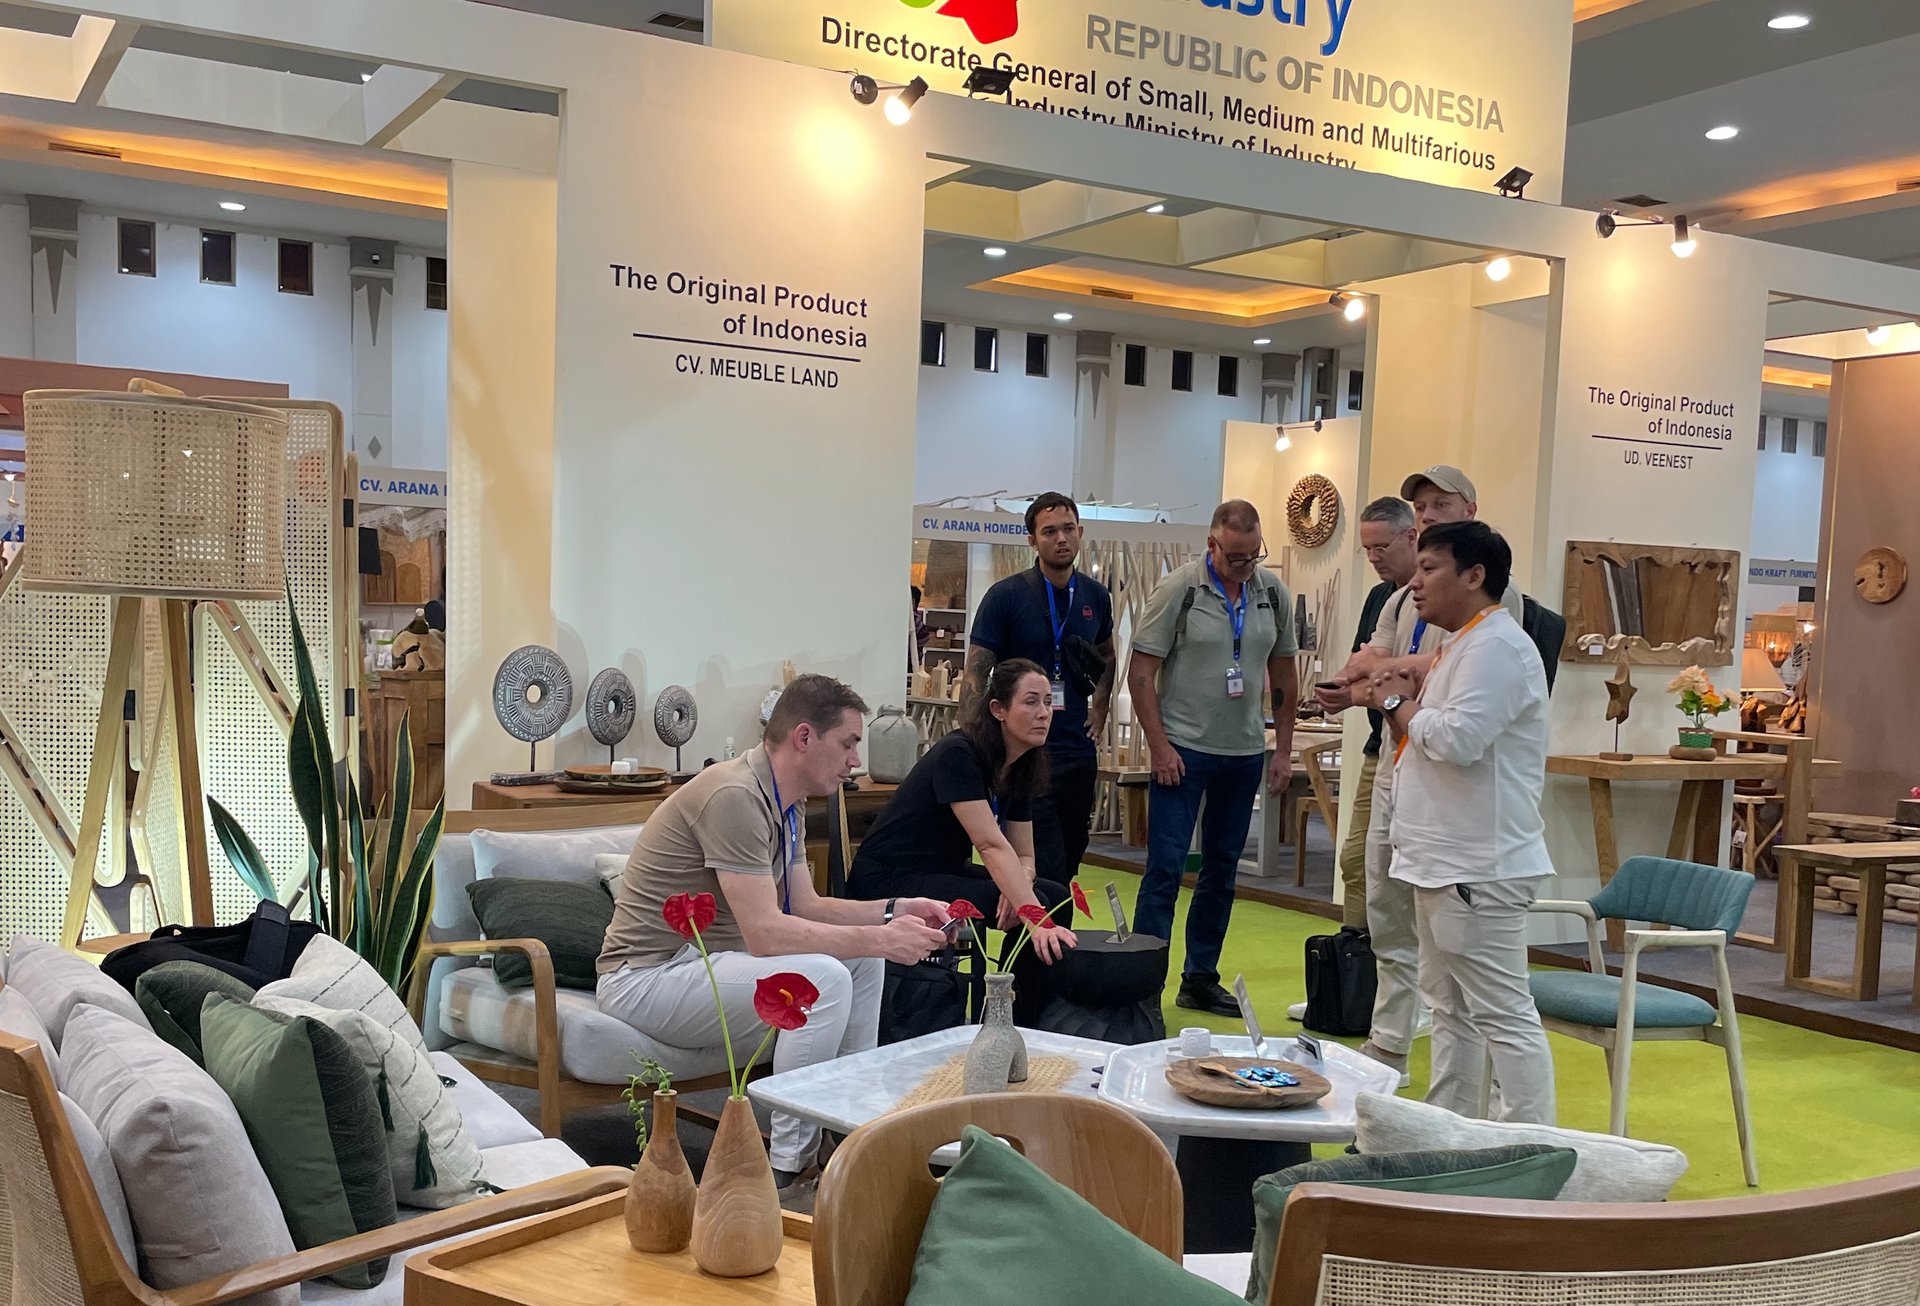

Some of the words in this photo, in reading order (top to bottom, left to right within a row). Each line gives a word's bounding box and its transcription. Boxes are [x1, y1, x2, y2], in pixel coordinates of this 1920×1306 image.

[1086, 13, 1268, 84] REPUBLIC
[1276, 55, 1325, 95] OF
[1332, 67, 1504, 133] INDONESIA
[822, 16, 982, 71] Directorate
[993, 52, 1096, 95] General
[1105, 76, 1131, 101] of
[1138, 80, 1214, 121] Small,
[1223, 96, 1314, 136] Medium
[1322, 122, 1364, 145] and
[1372, 125, 1496, 171] Multifarious
[610, 264, 657, 291] The
[667, 272, 765, 304] Original
[774, 286, 867, 318] Product
[723, 314, 746, 335] of
[752, 315, 867, 348] Indonesia
[675, 354, 703, 375] CV.
[710, 358, 785, 383] MEUBLE
[792, 367, 838, 388] LAND
[1588, 386, 1615, 405] The
[1620, 390, 1676, 412] Original
[1680, 396, 1734, 418] Product
[1648, 418, 1663, 434] of
[1666, 419, 1732, 440] Indonesia
[1624, 450, 1642, 465] UD.
[1645, 452, 1694, 470] VEENEST
[360, 479, 382, 492] CV.
[388, 480, 439, 496] ARANA
[922, 518, 938, 530] CV.
[943, 520, 981, 532] ARANA
[1765, 568, 1787, 578] KRAFT
